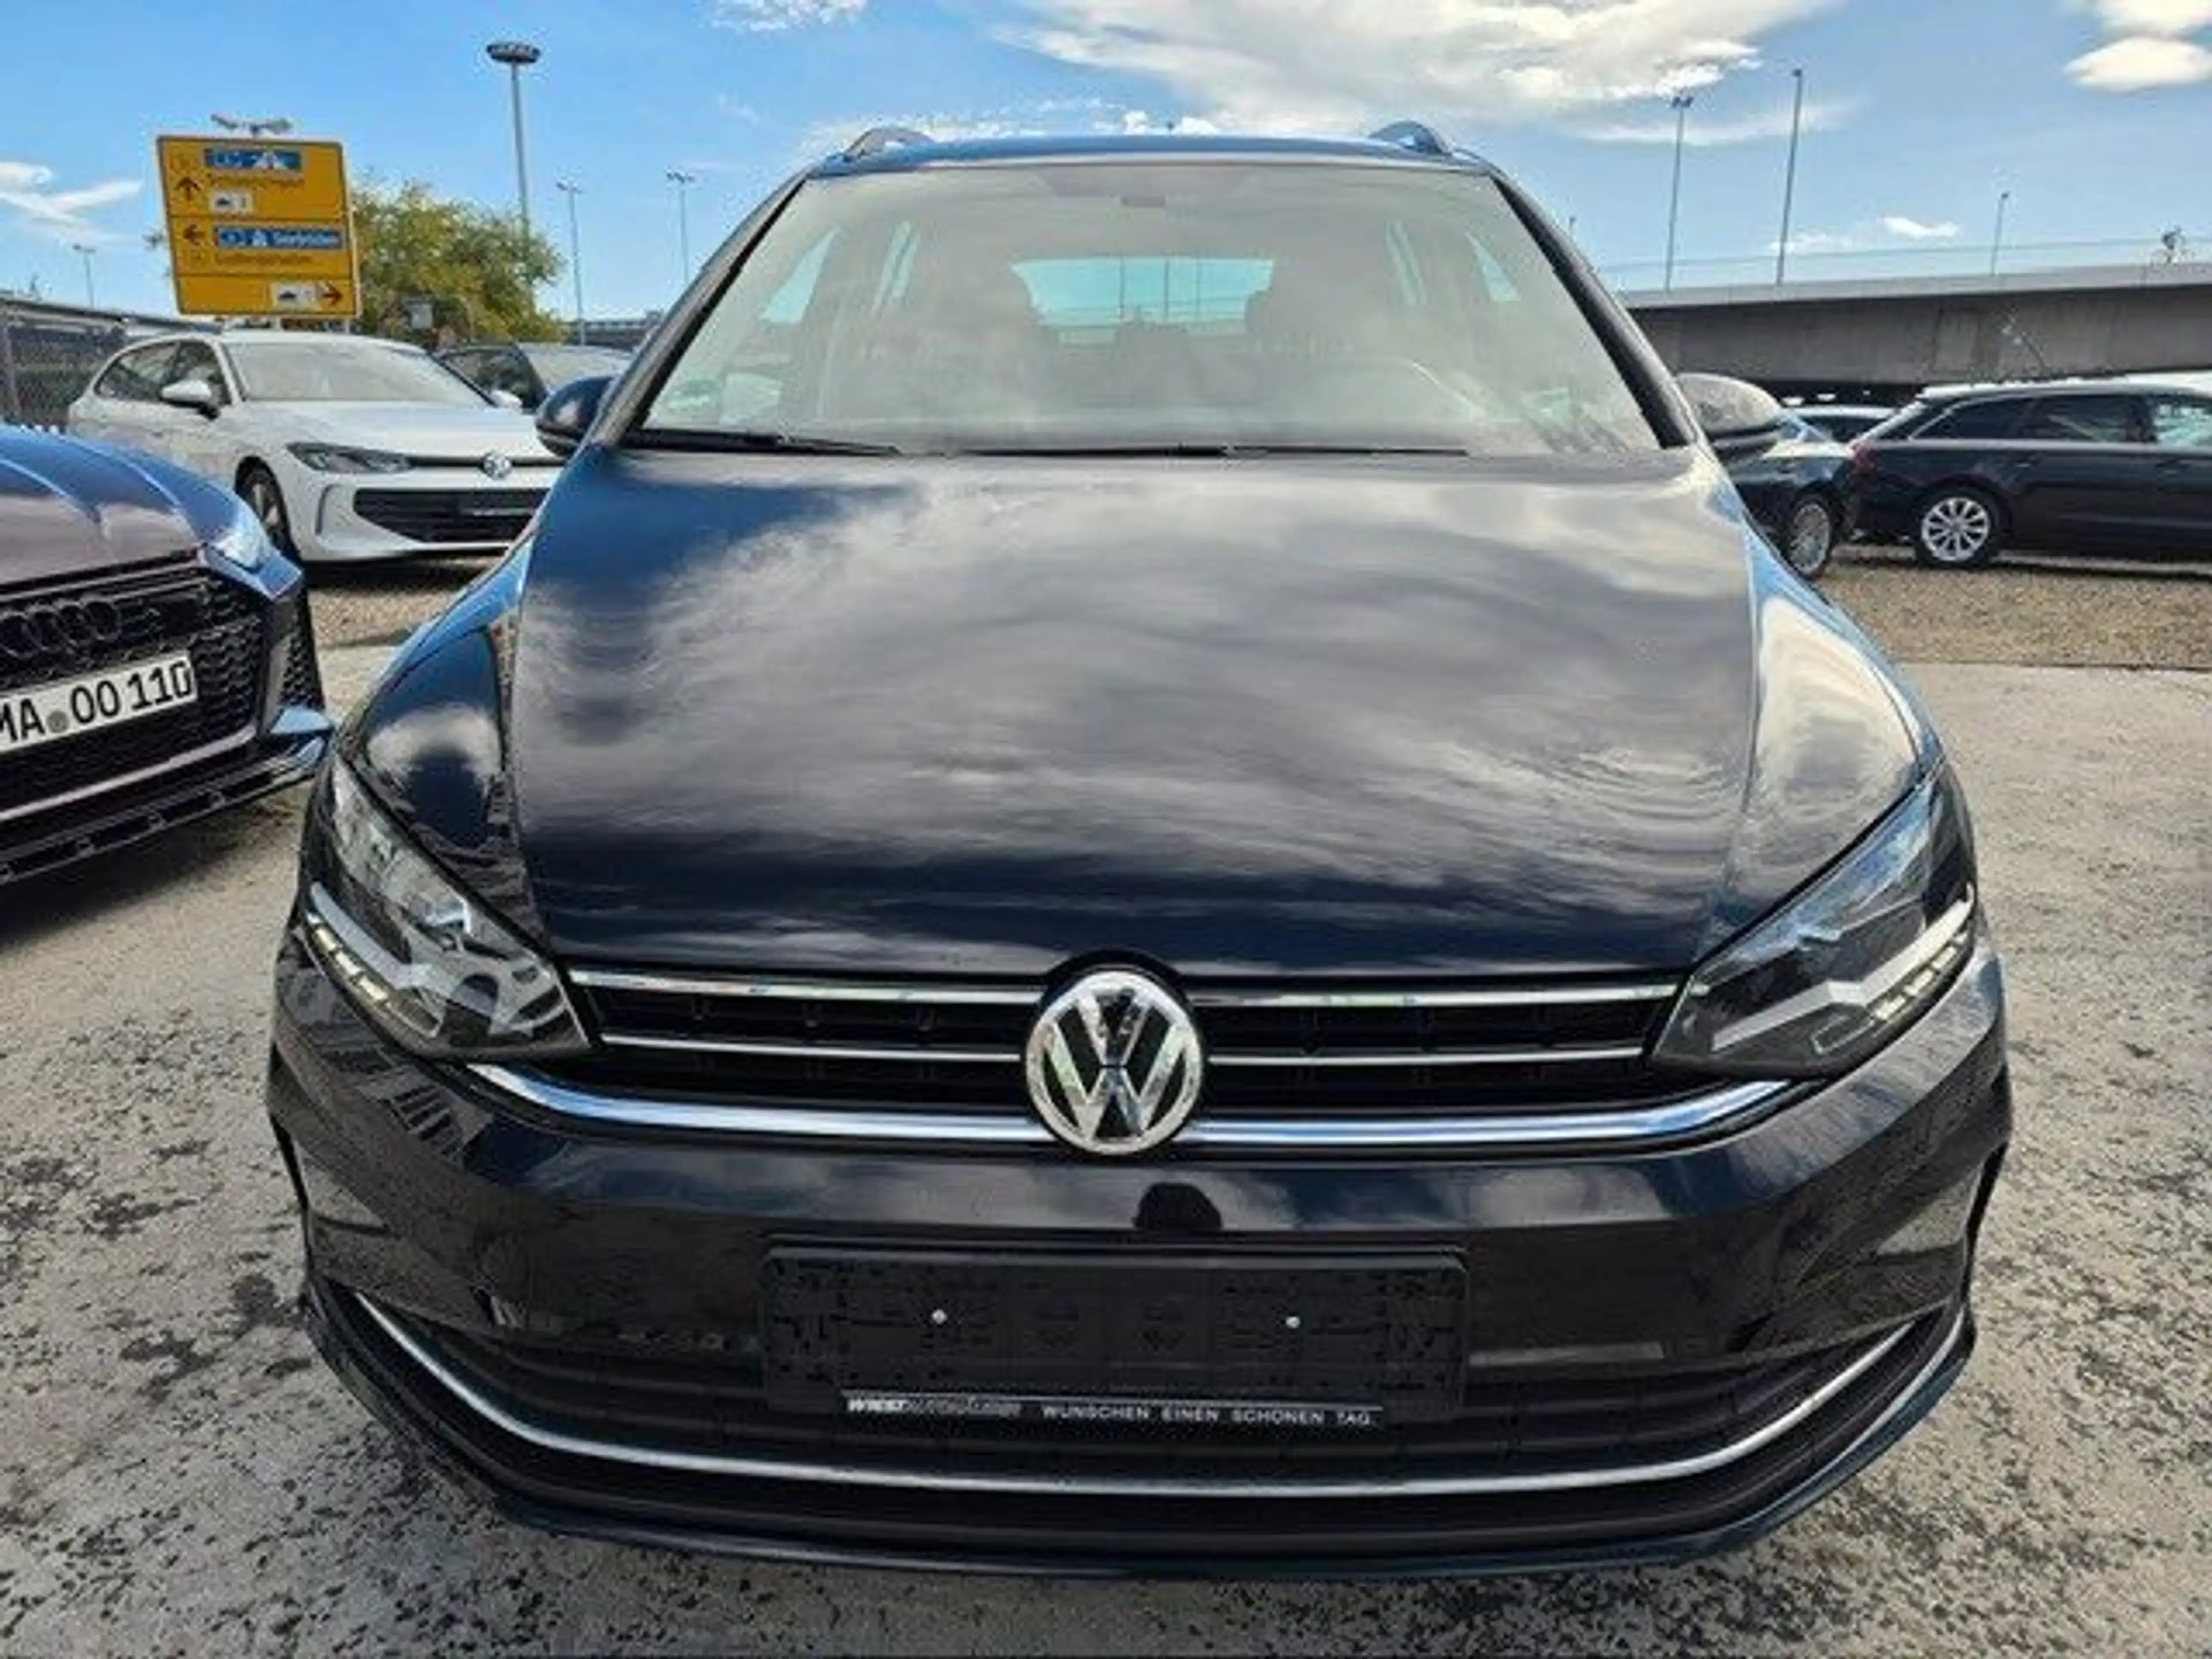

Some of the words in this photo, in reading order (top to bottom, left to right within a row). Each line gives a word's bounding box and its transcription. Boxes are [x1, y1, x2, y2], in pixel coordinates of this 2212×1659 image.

[128, 662, 191, 709] 110
[1027, 972, 1200, 1154] VW
[1161, 1406, 1218, 1422] EINEN
